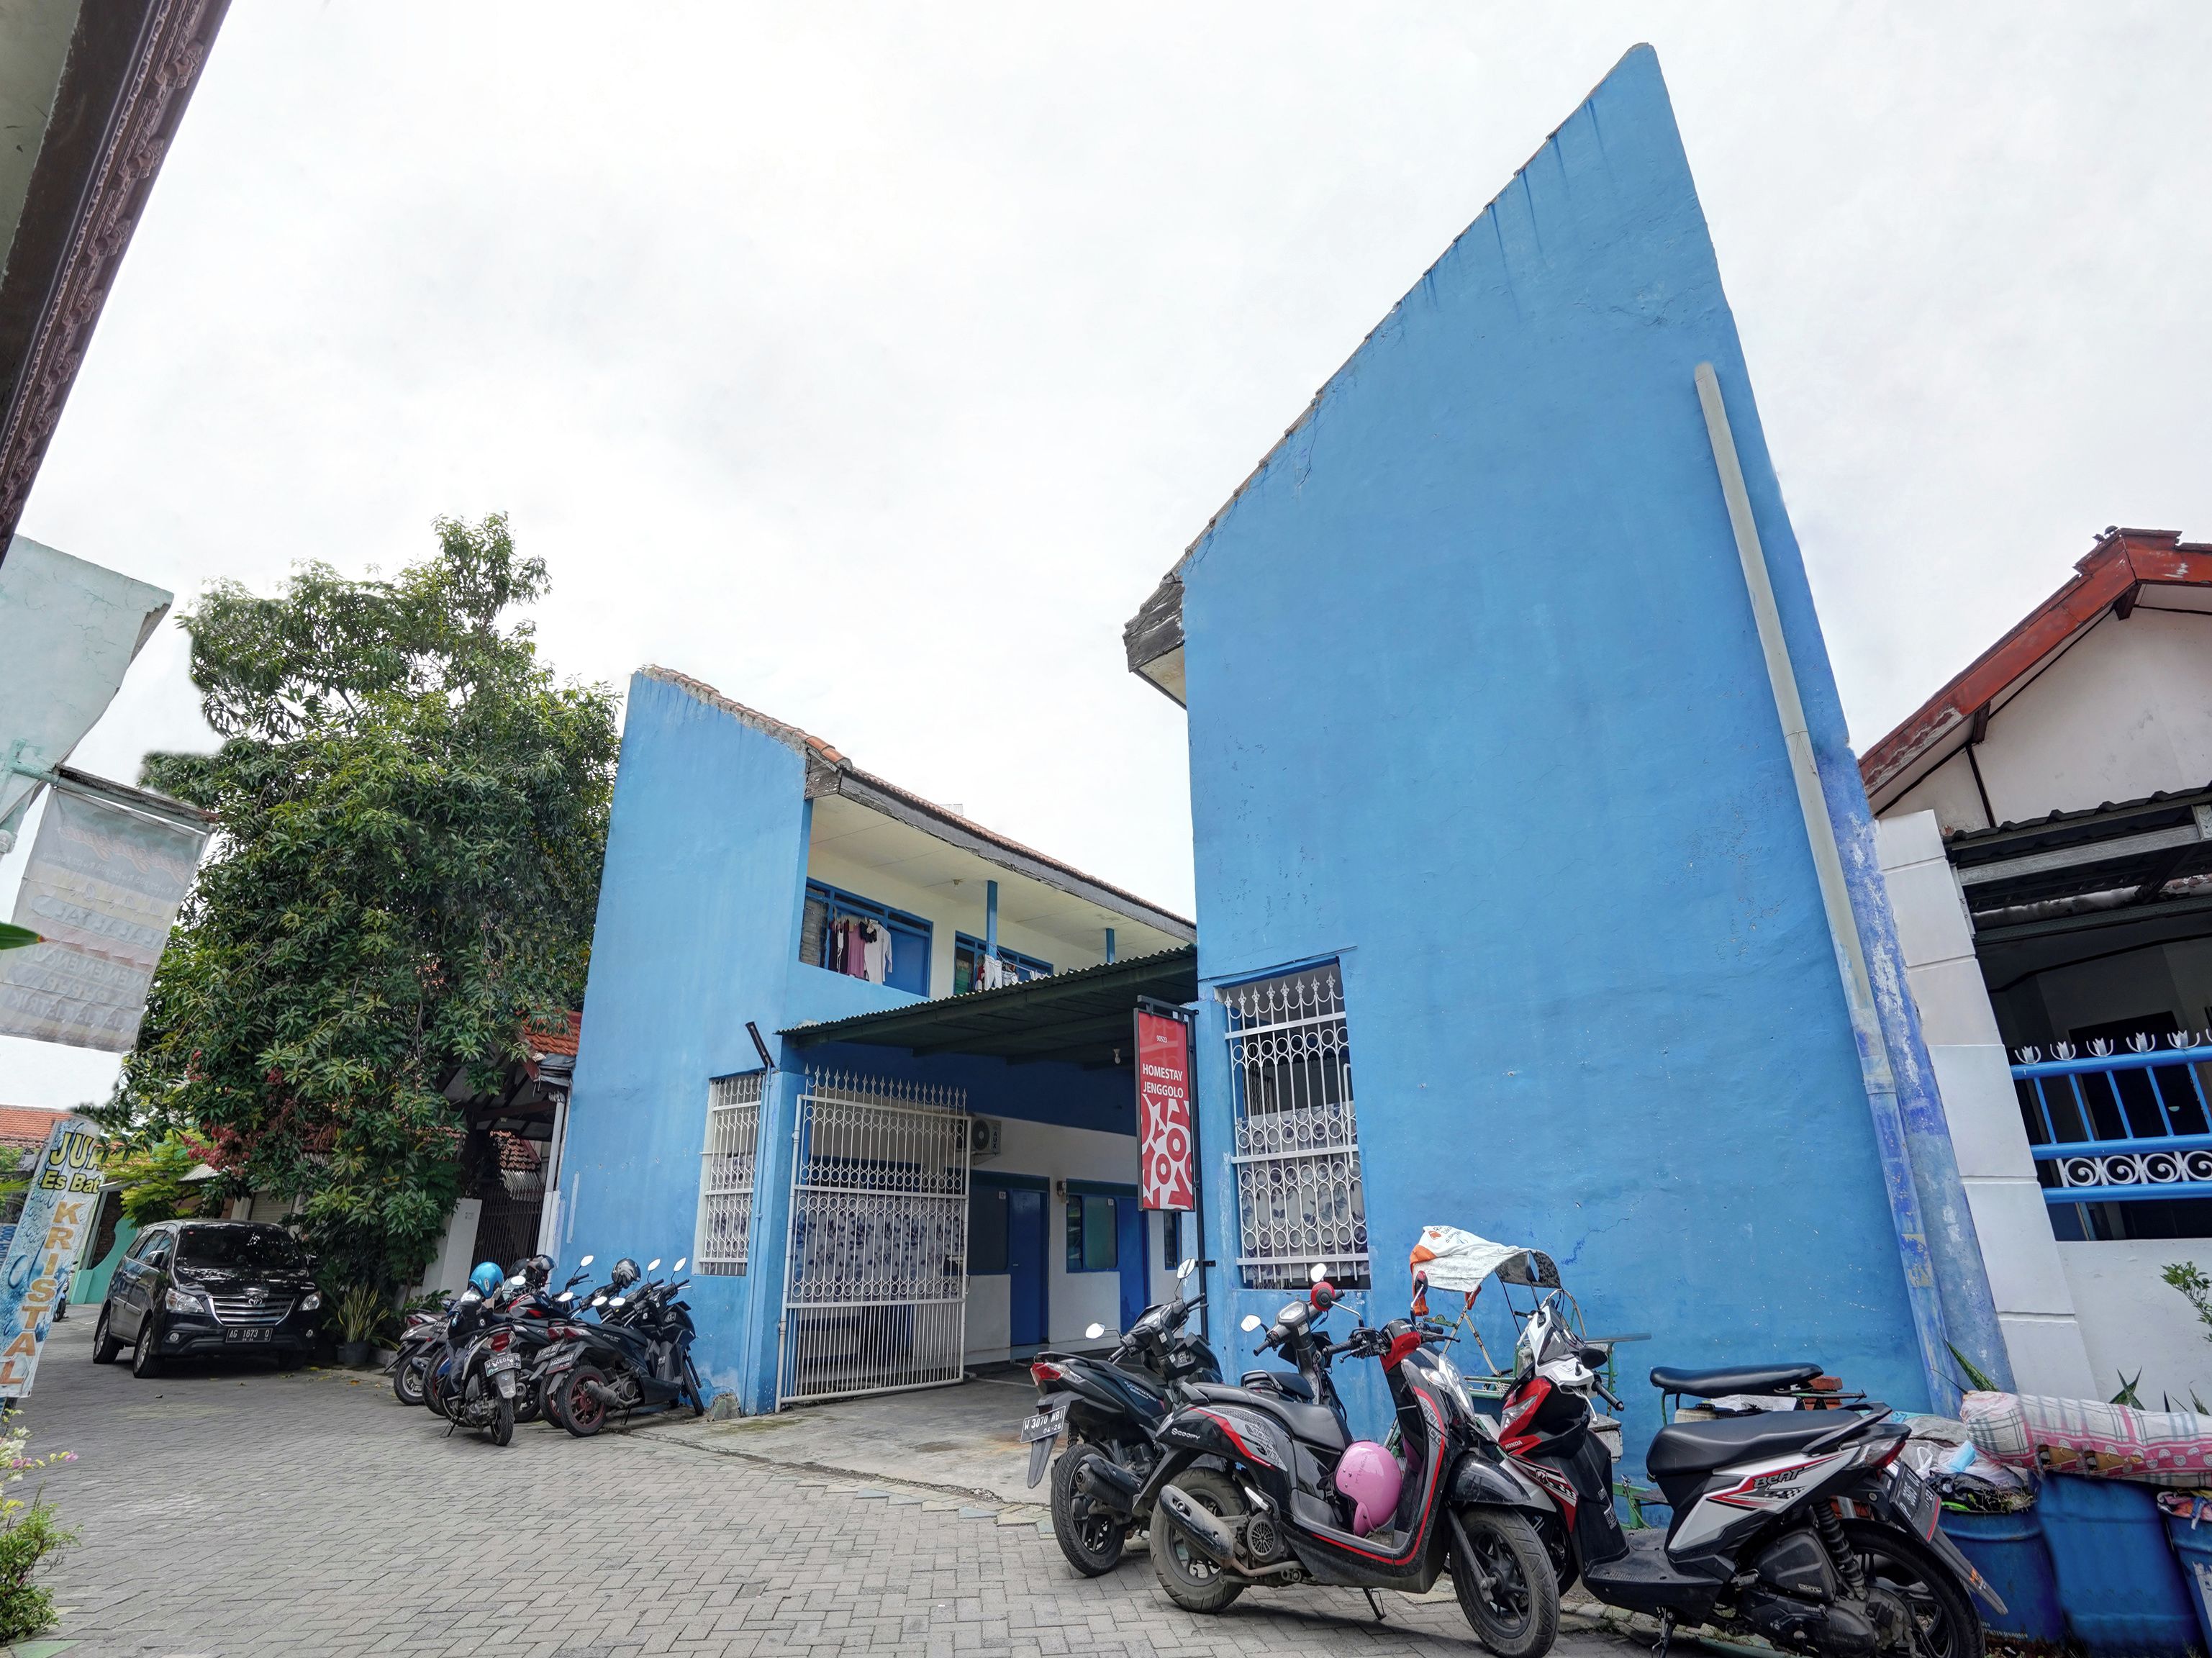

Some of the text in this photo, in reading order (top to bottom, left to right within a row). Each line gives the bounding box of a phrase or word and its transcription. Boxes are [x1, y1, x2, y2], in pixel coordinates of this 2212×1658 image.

[1143, 1063, 1183, 1082] HOMESTAY
[1143, 1081, 1184, 1099] JENGGOLO
[41, 1169, 68, 1190] Es
[0, 1200, 82, 1385] KRISTAL
[242, 1329, 258, 1338] 1673
[1024, 1420, 1030, 1431] W
[1030, 1414, 1048, 1429] 3070
[1505, 1439, 1523, 1449] HONDA
[1899, 1502, 1912, 1518] P
